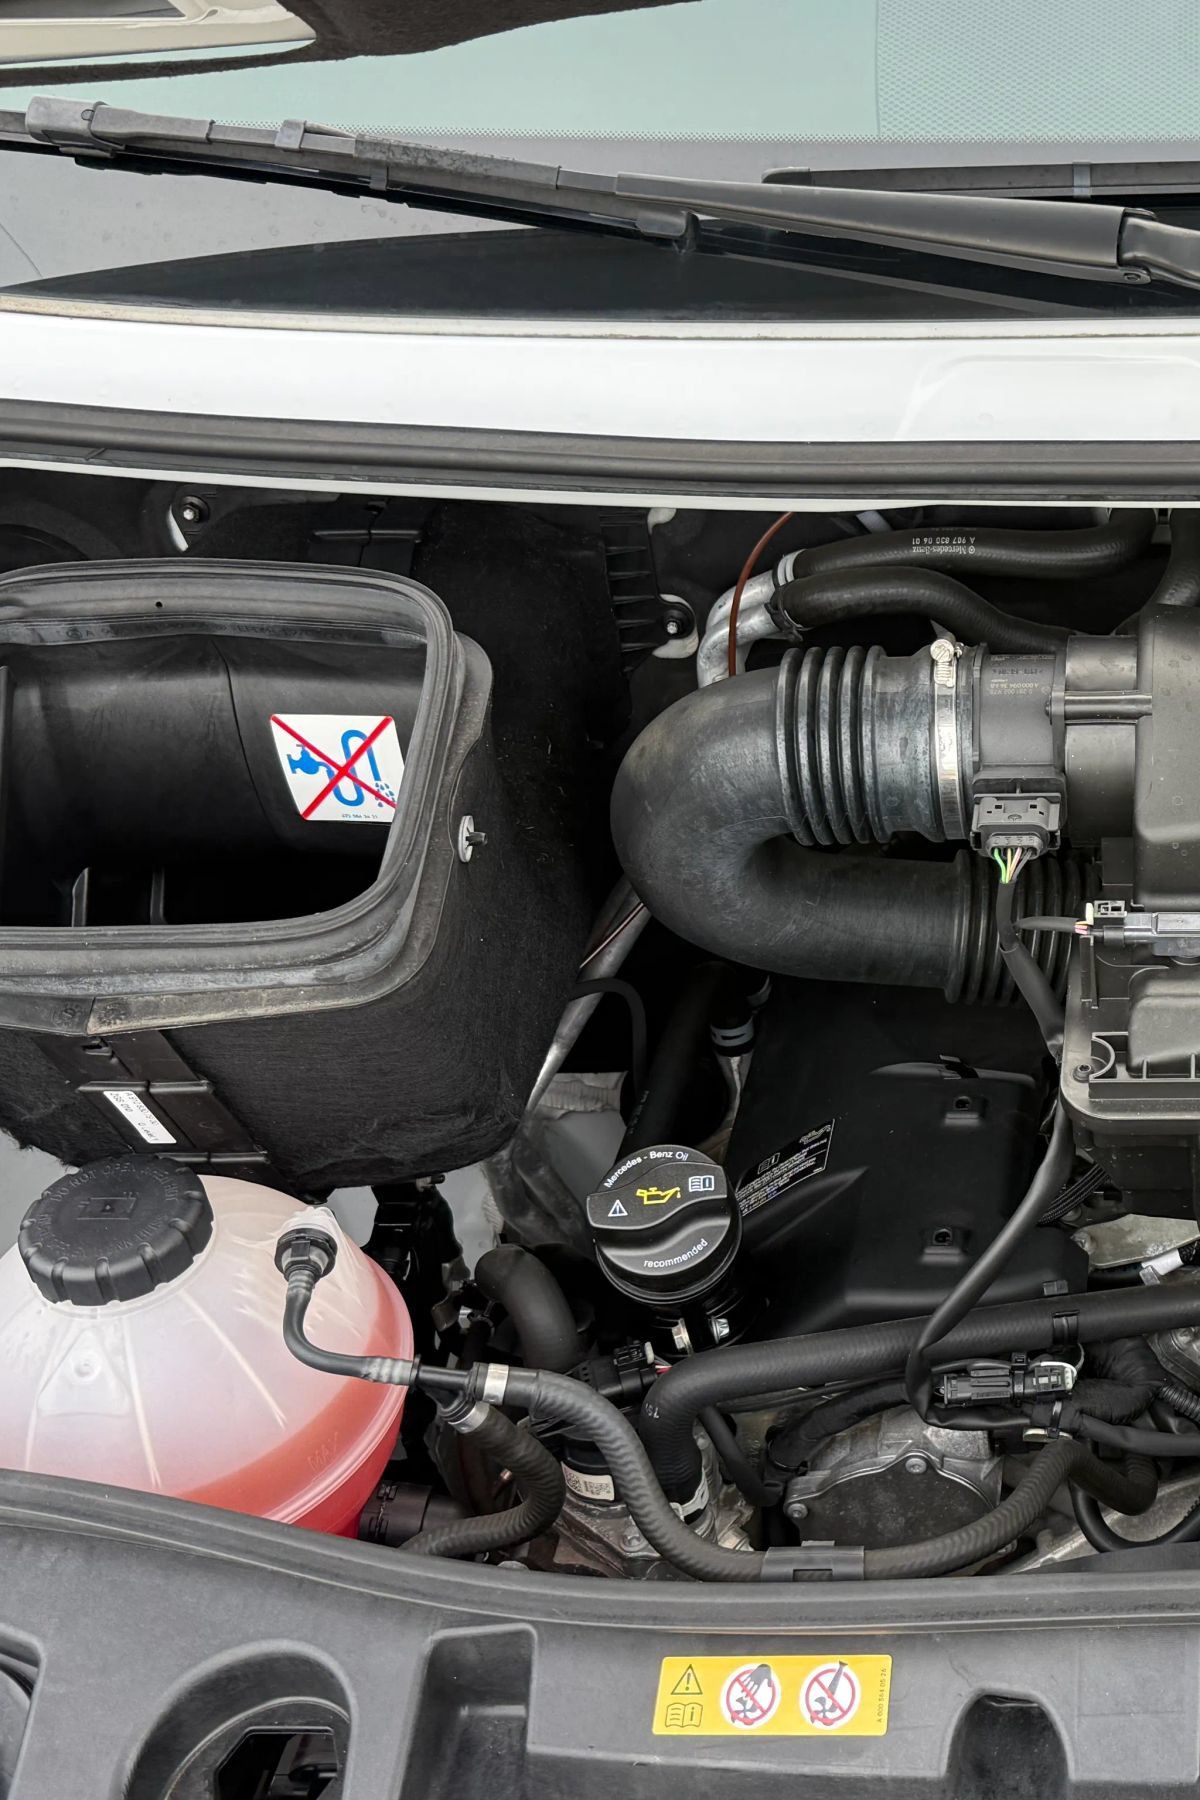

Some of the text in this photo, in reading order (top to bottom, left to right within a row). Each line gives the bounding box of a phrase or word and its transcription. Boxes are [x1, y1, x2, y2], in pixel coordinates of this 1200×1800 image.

[603, 1157, 642, 1189] Mercedes
[650, 1150, 674, 1160] Benz
[676, 1151, 689, 1162] Oil
[643, 1238, 708, 1269] recommended
